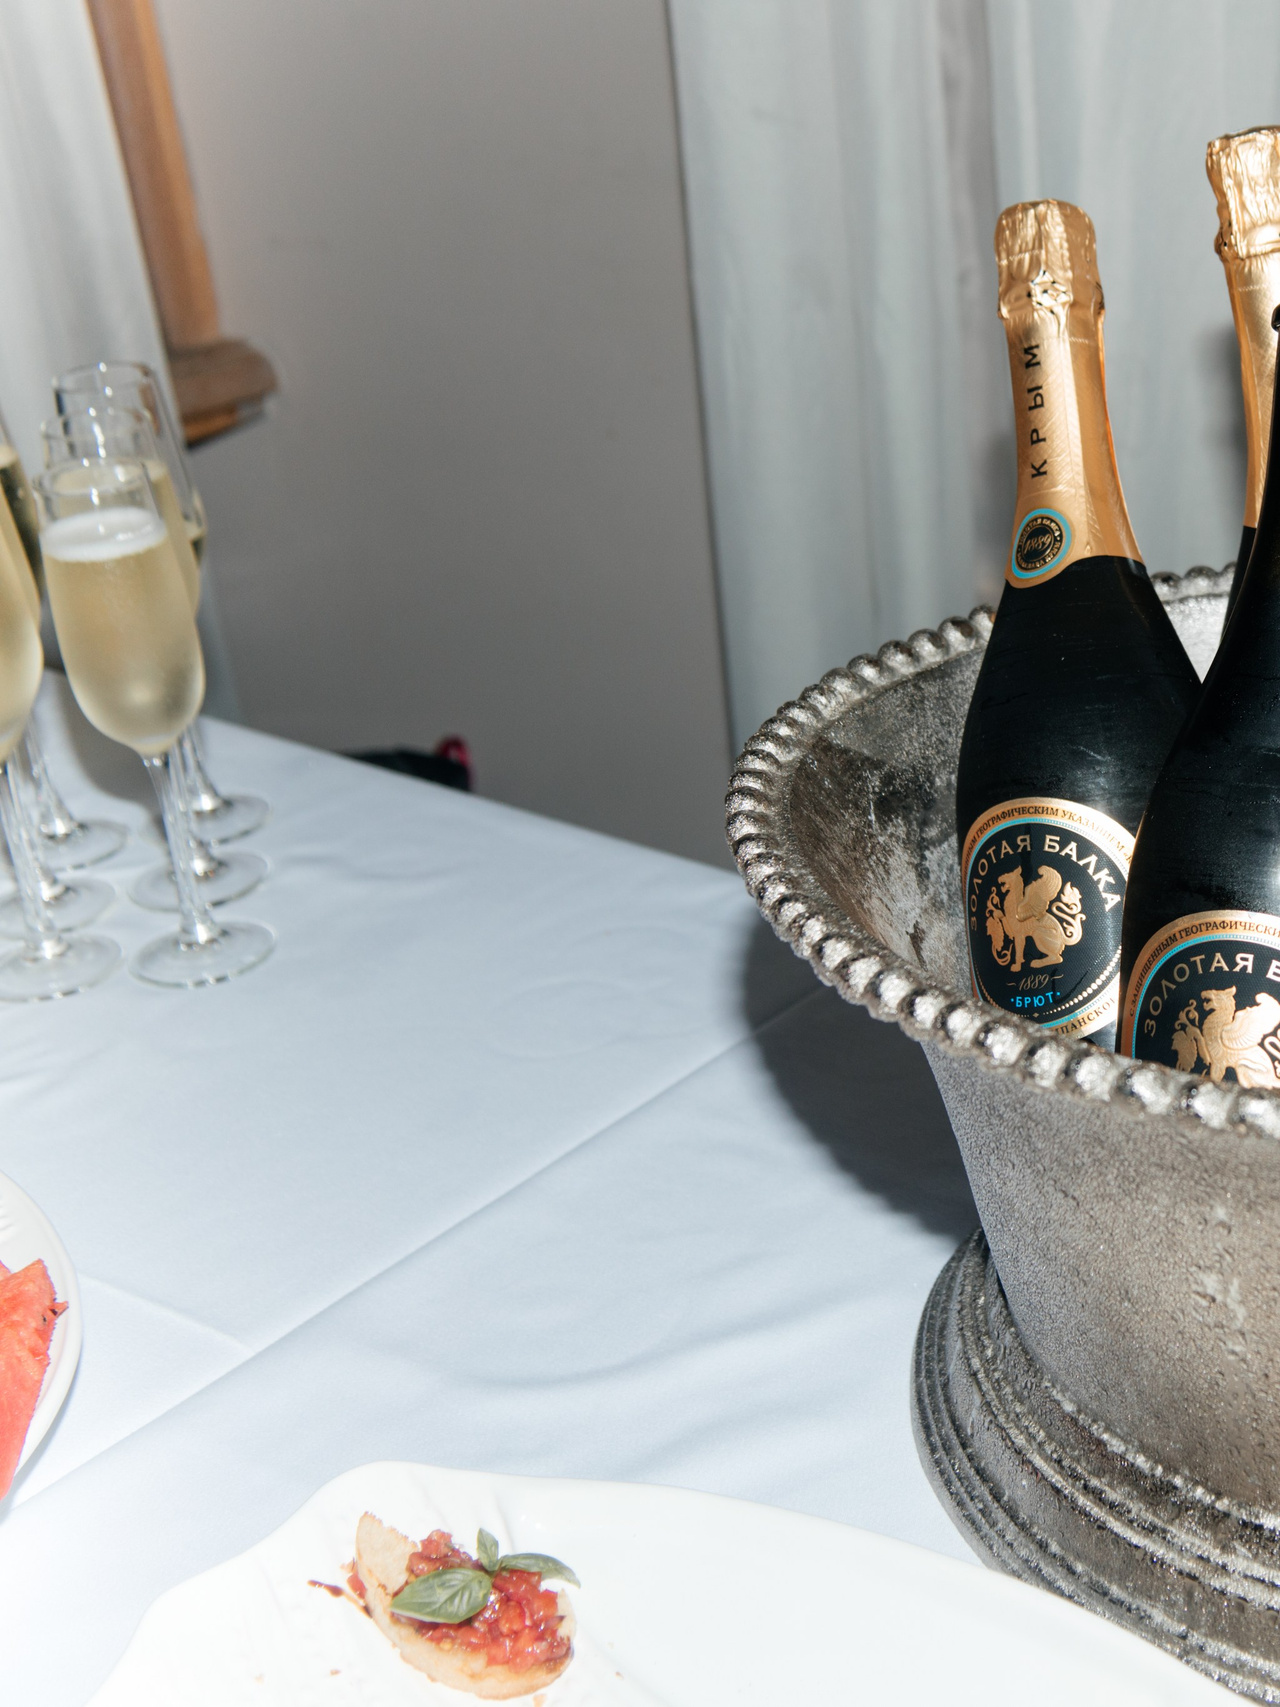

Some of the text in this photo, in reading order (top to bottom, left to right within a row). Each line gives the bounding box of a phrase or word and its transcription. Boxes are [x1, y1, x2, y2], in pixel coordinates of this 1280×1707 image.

[1023, 343, 1048, 479] КРЫМ
[975, 802, 1059, 838] ГЕОГРАФИЧЕСКИМ
[970, 834, 1122, 931] ЗОЛОТАЯ БАЛКА
[1014, 991, 1056, 1008] БРЮТ
[1017, 973, 1050, 992] 1889
[1143, 952, 1255, 1039] ЗОЛОТАЯ
